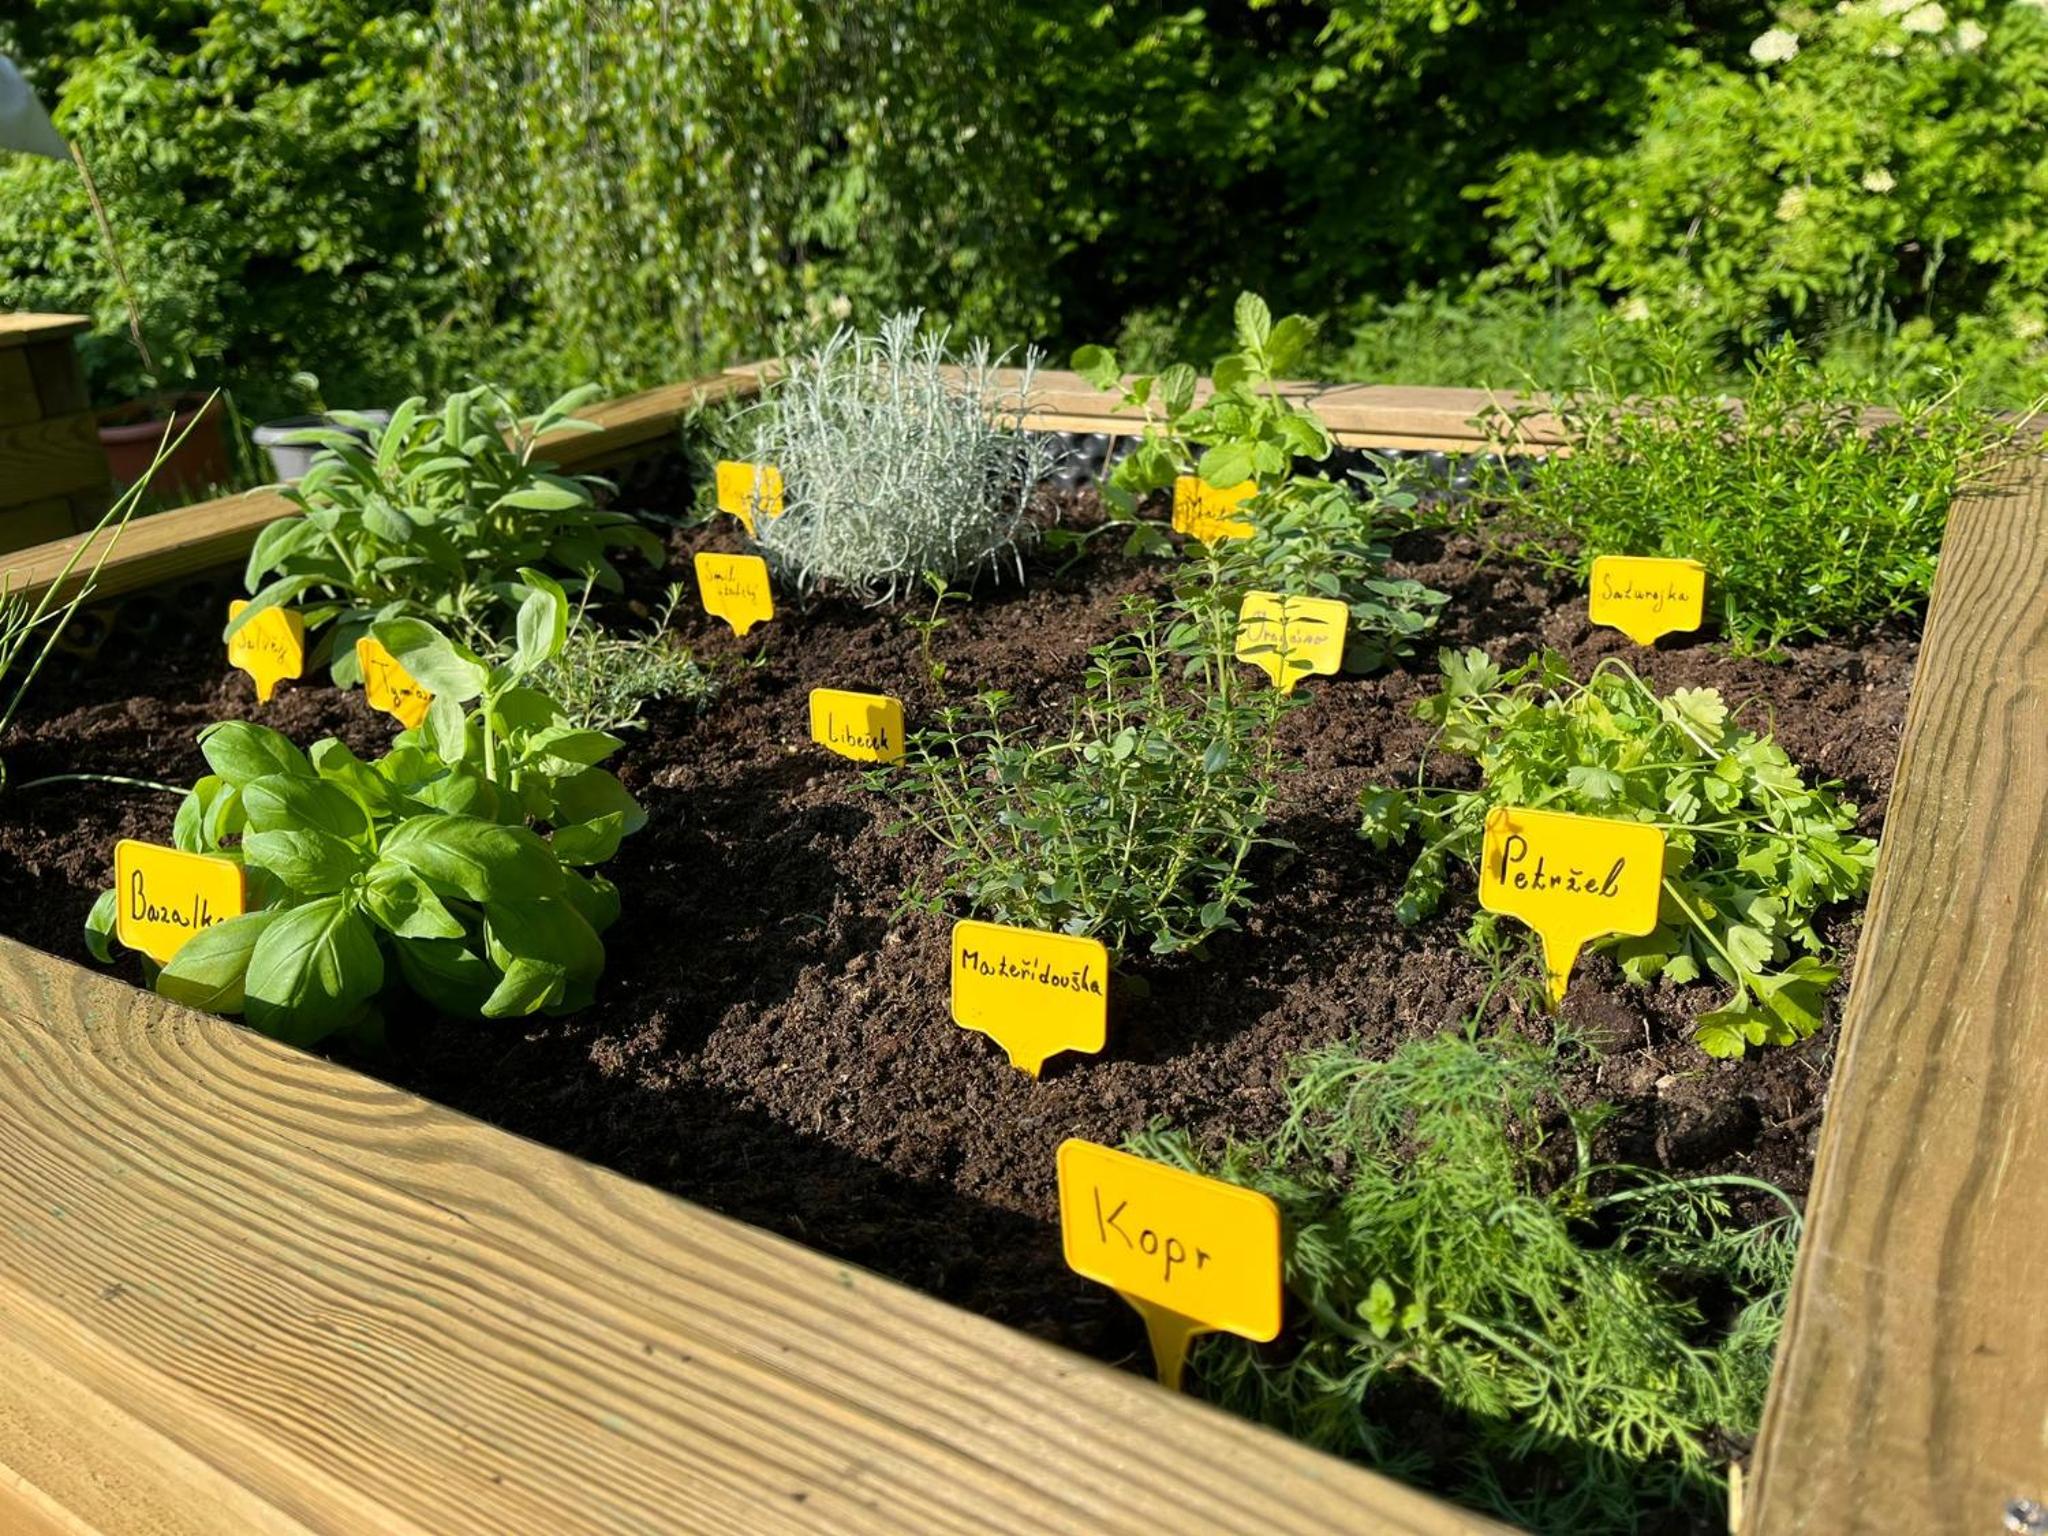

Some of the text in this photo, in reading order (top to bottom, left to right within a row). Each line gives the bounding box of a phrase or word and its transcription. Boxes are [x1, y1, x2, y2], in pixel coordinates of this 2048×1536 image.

[1500, 833, 1626, 898] Petržel
[131, 868, 225, 929] Bazalk
[961, 947, 1103, 996] Mateřídouška
[1094, 1185, 1212, 1282] Kopr
